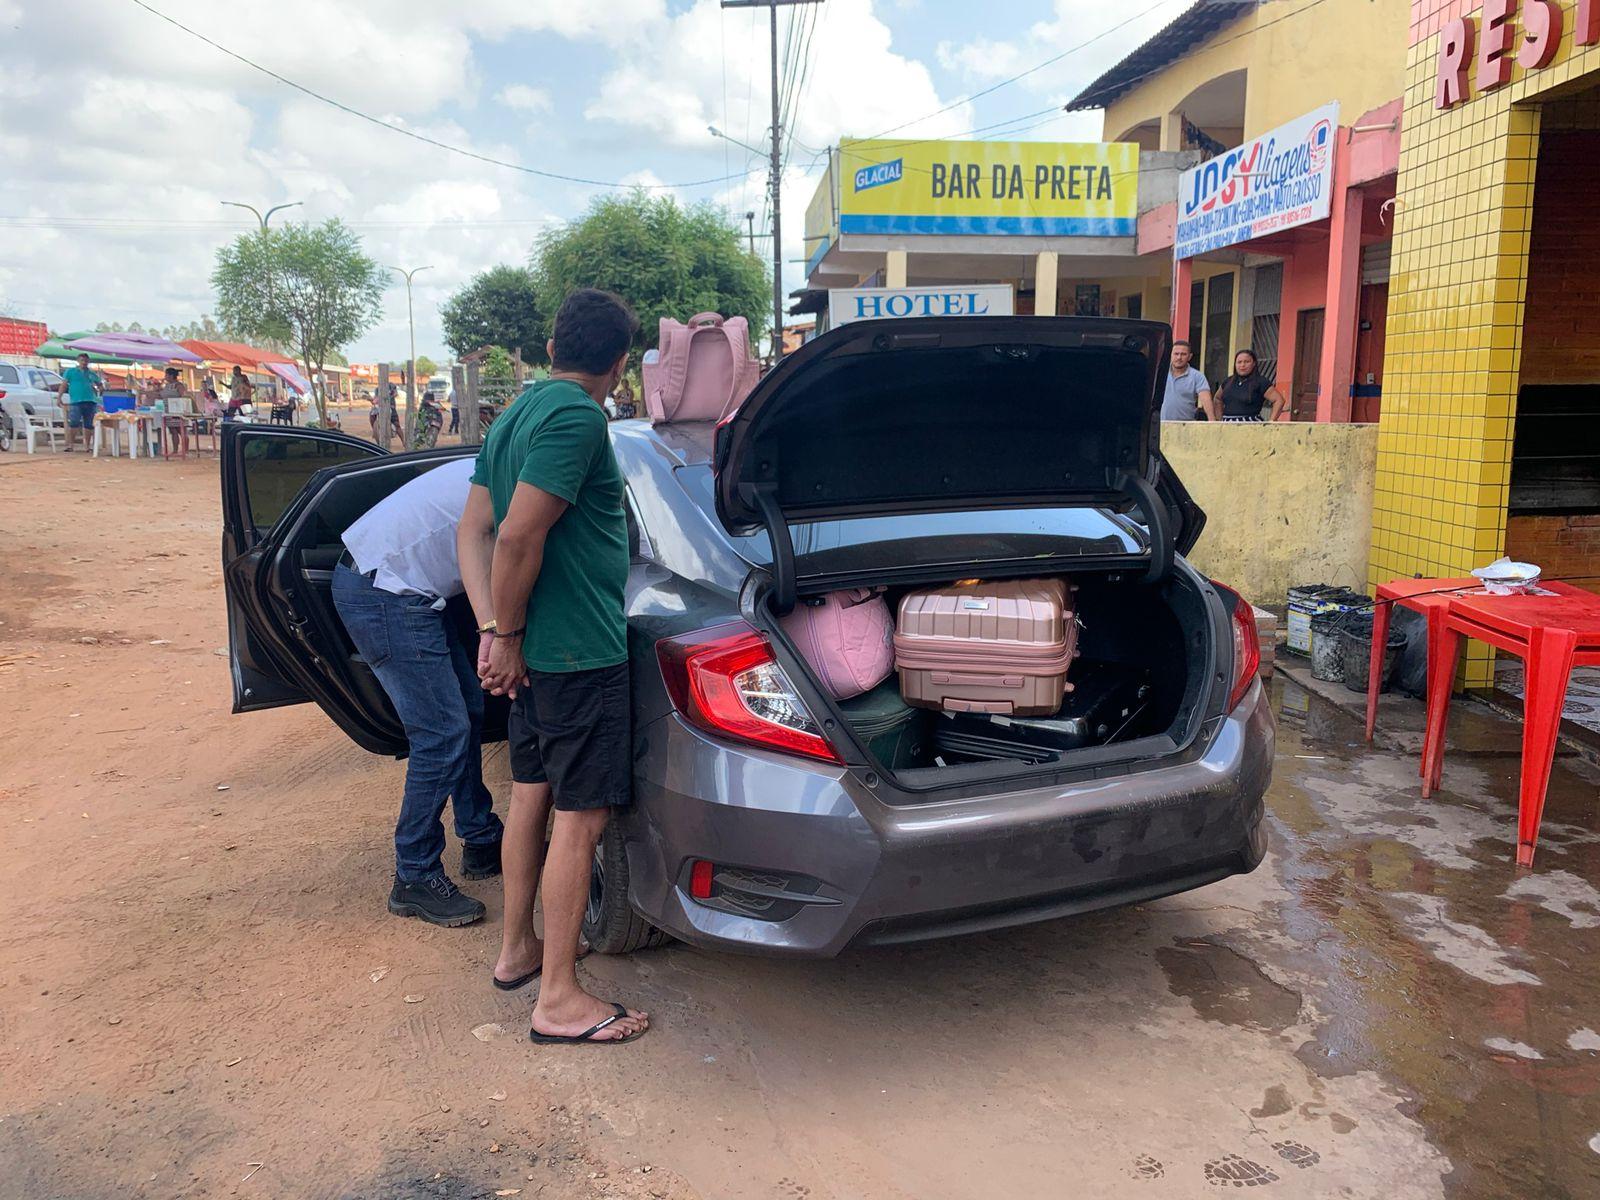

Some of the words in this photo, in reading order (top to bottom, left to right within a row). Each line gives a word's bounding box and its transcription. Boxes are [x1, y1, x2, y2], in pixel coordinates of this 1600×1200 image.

[855, 162, 902, 188] GLACIAL
[931, 163, 981, 199] BAR
[992, 164, 1024, 200] DA
[1034, 165, 1112, 200] PRETA
[1185, 141, 1260, 218] JOSY
[853, 293, 989, 319] HOTEL
